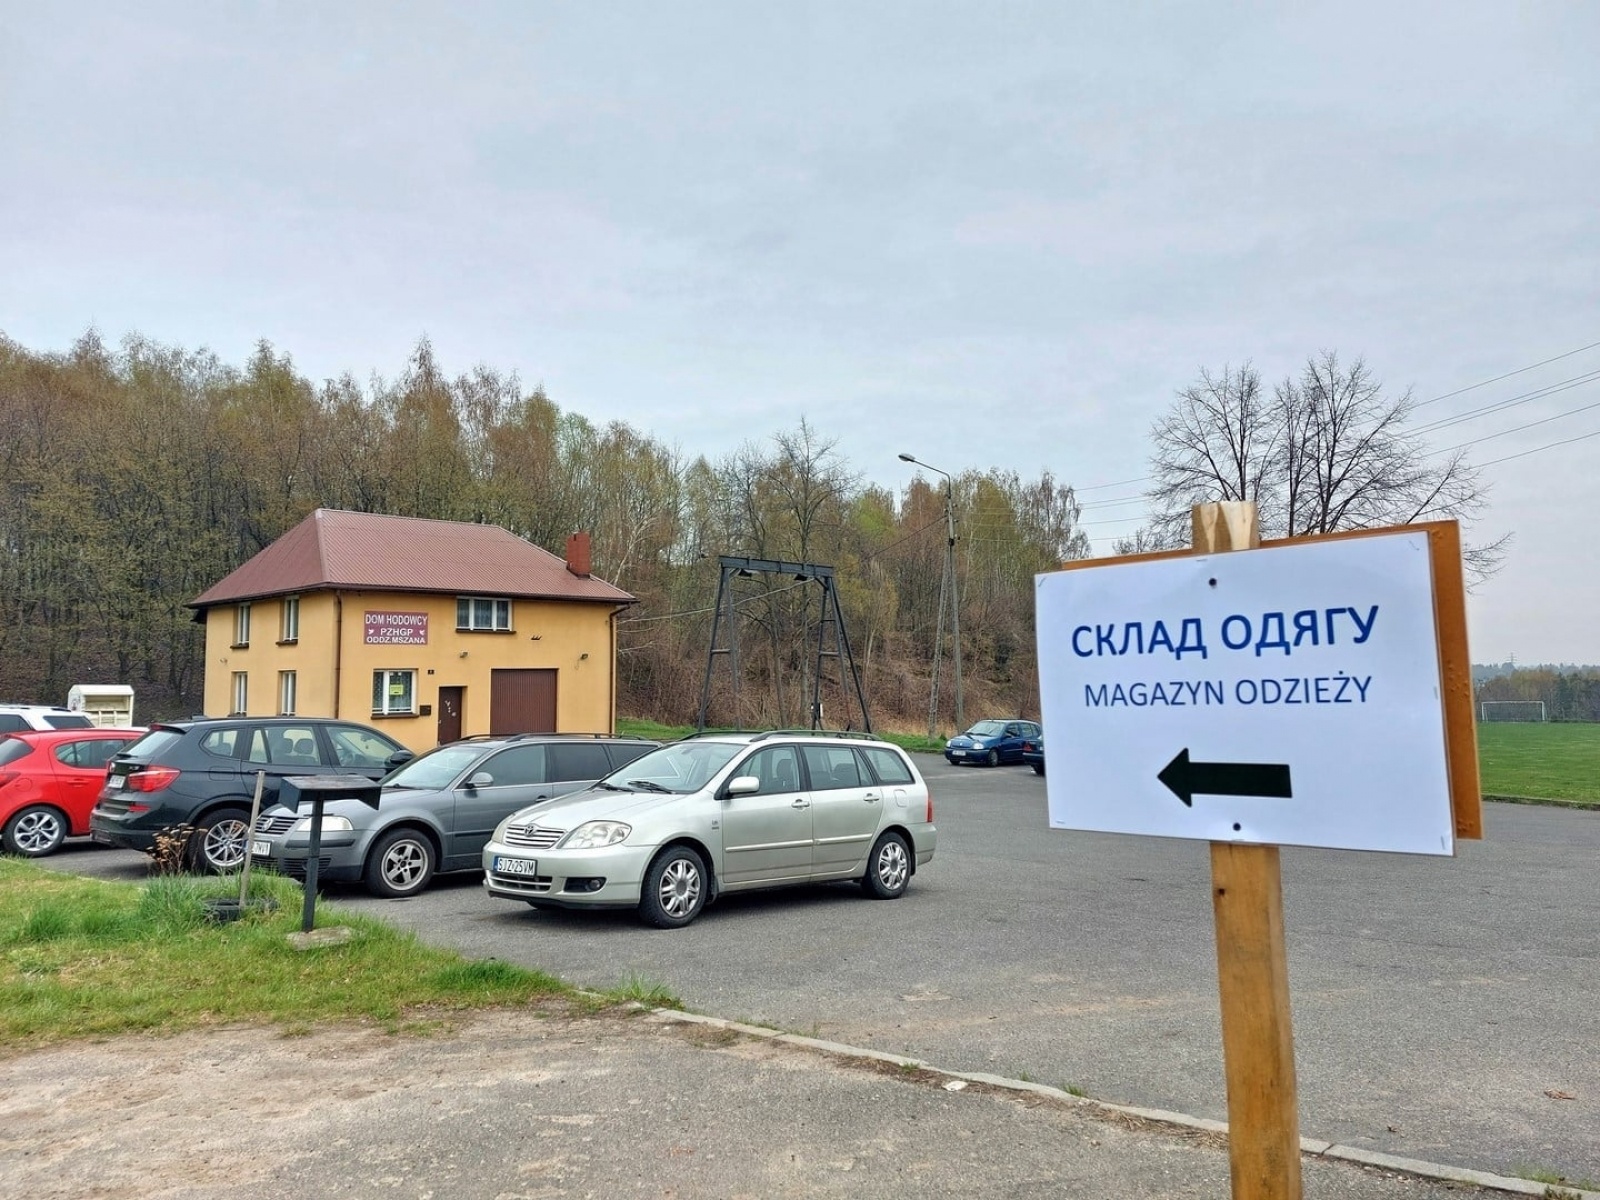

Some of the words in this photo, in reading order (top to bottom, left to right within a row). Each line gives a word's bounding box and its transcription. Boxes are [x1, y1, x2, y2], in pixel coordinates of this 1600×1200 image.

[365, 614, 384, 624] DOM
[386, 614, 428, 625] HODOWCY
[380, 628, 413, 636] PZHGP
[1072, 618, 1207, 660] СКЛАД
[1221, 605, 1378, 657] ОДЯГУ
[1085, 680, 1224, 706] MAGAZYN
[1235, 671, 1372, 704] ODZIEŻY
